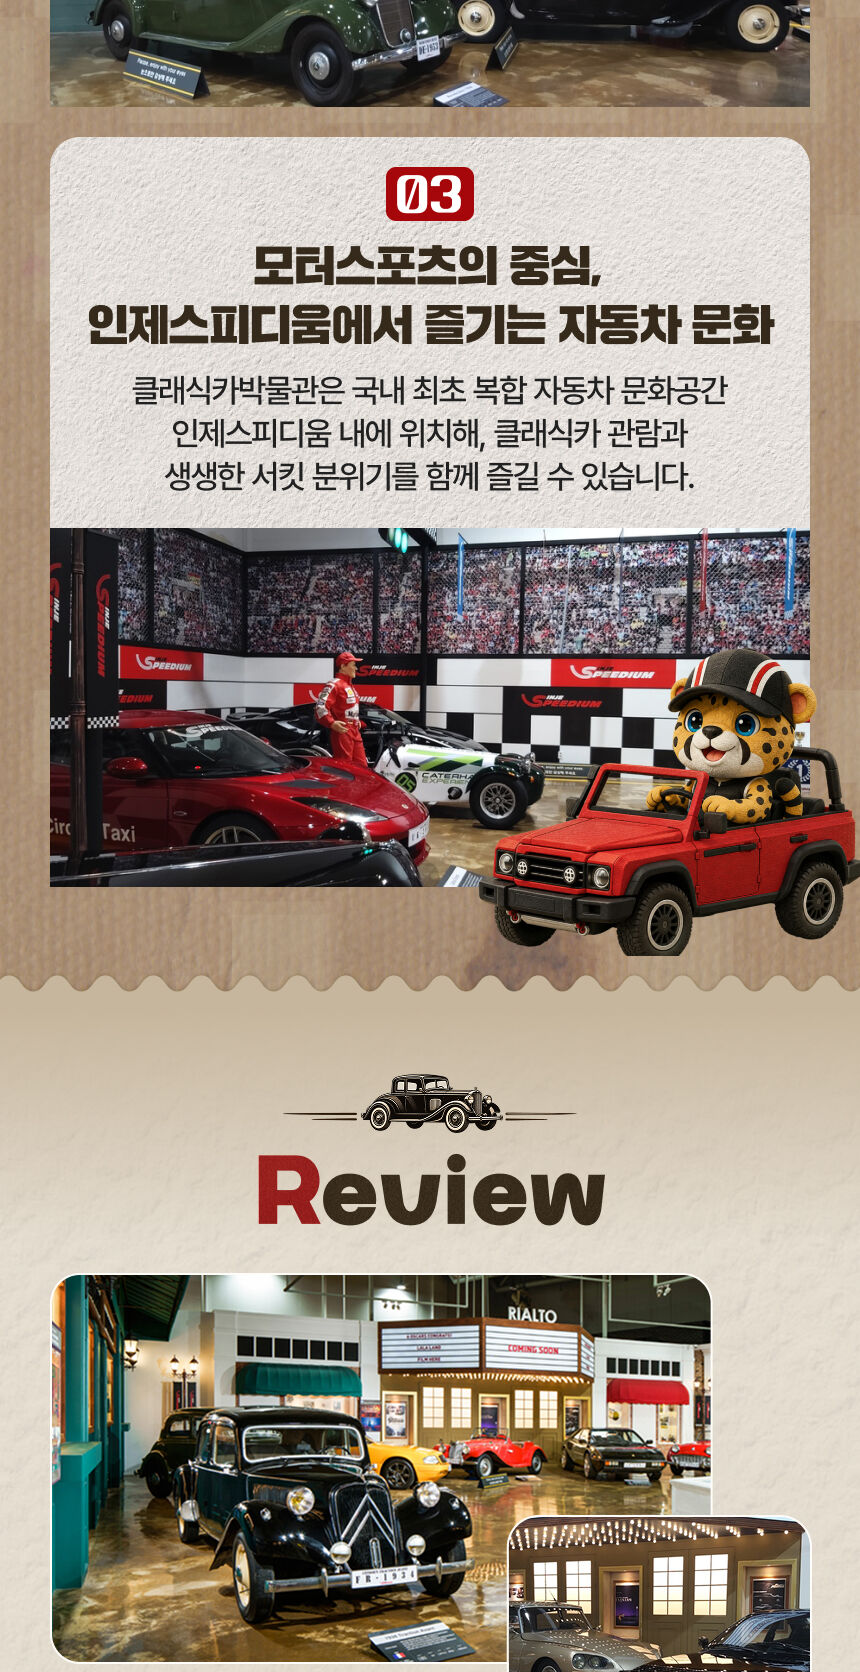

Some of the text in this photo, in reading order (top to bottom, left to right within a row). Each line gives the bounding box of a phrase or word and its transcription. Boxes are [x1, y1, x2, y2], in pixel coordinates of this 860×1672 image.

[96, 574, 111, 677] SPEEDIUM
[136, 654, 192, 671] SPEEDIUM
[357, 665, 419, 677] SPEEDIUM
[570, 665, 655, 679] SPEEDIUM
[521, 694, 602, 707] SPEEDIUM
[102, 824, 135, 842] Taxi
[508, 1307, 558, 1324] RIALTO
[508, 1344, 559, 1355] COMING SOON
